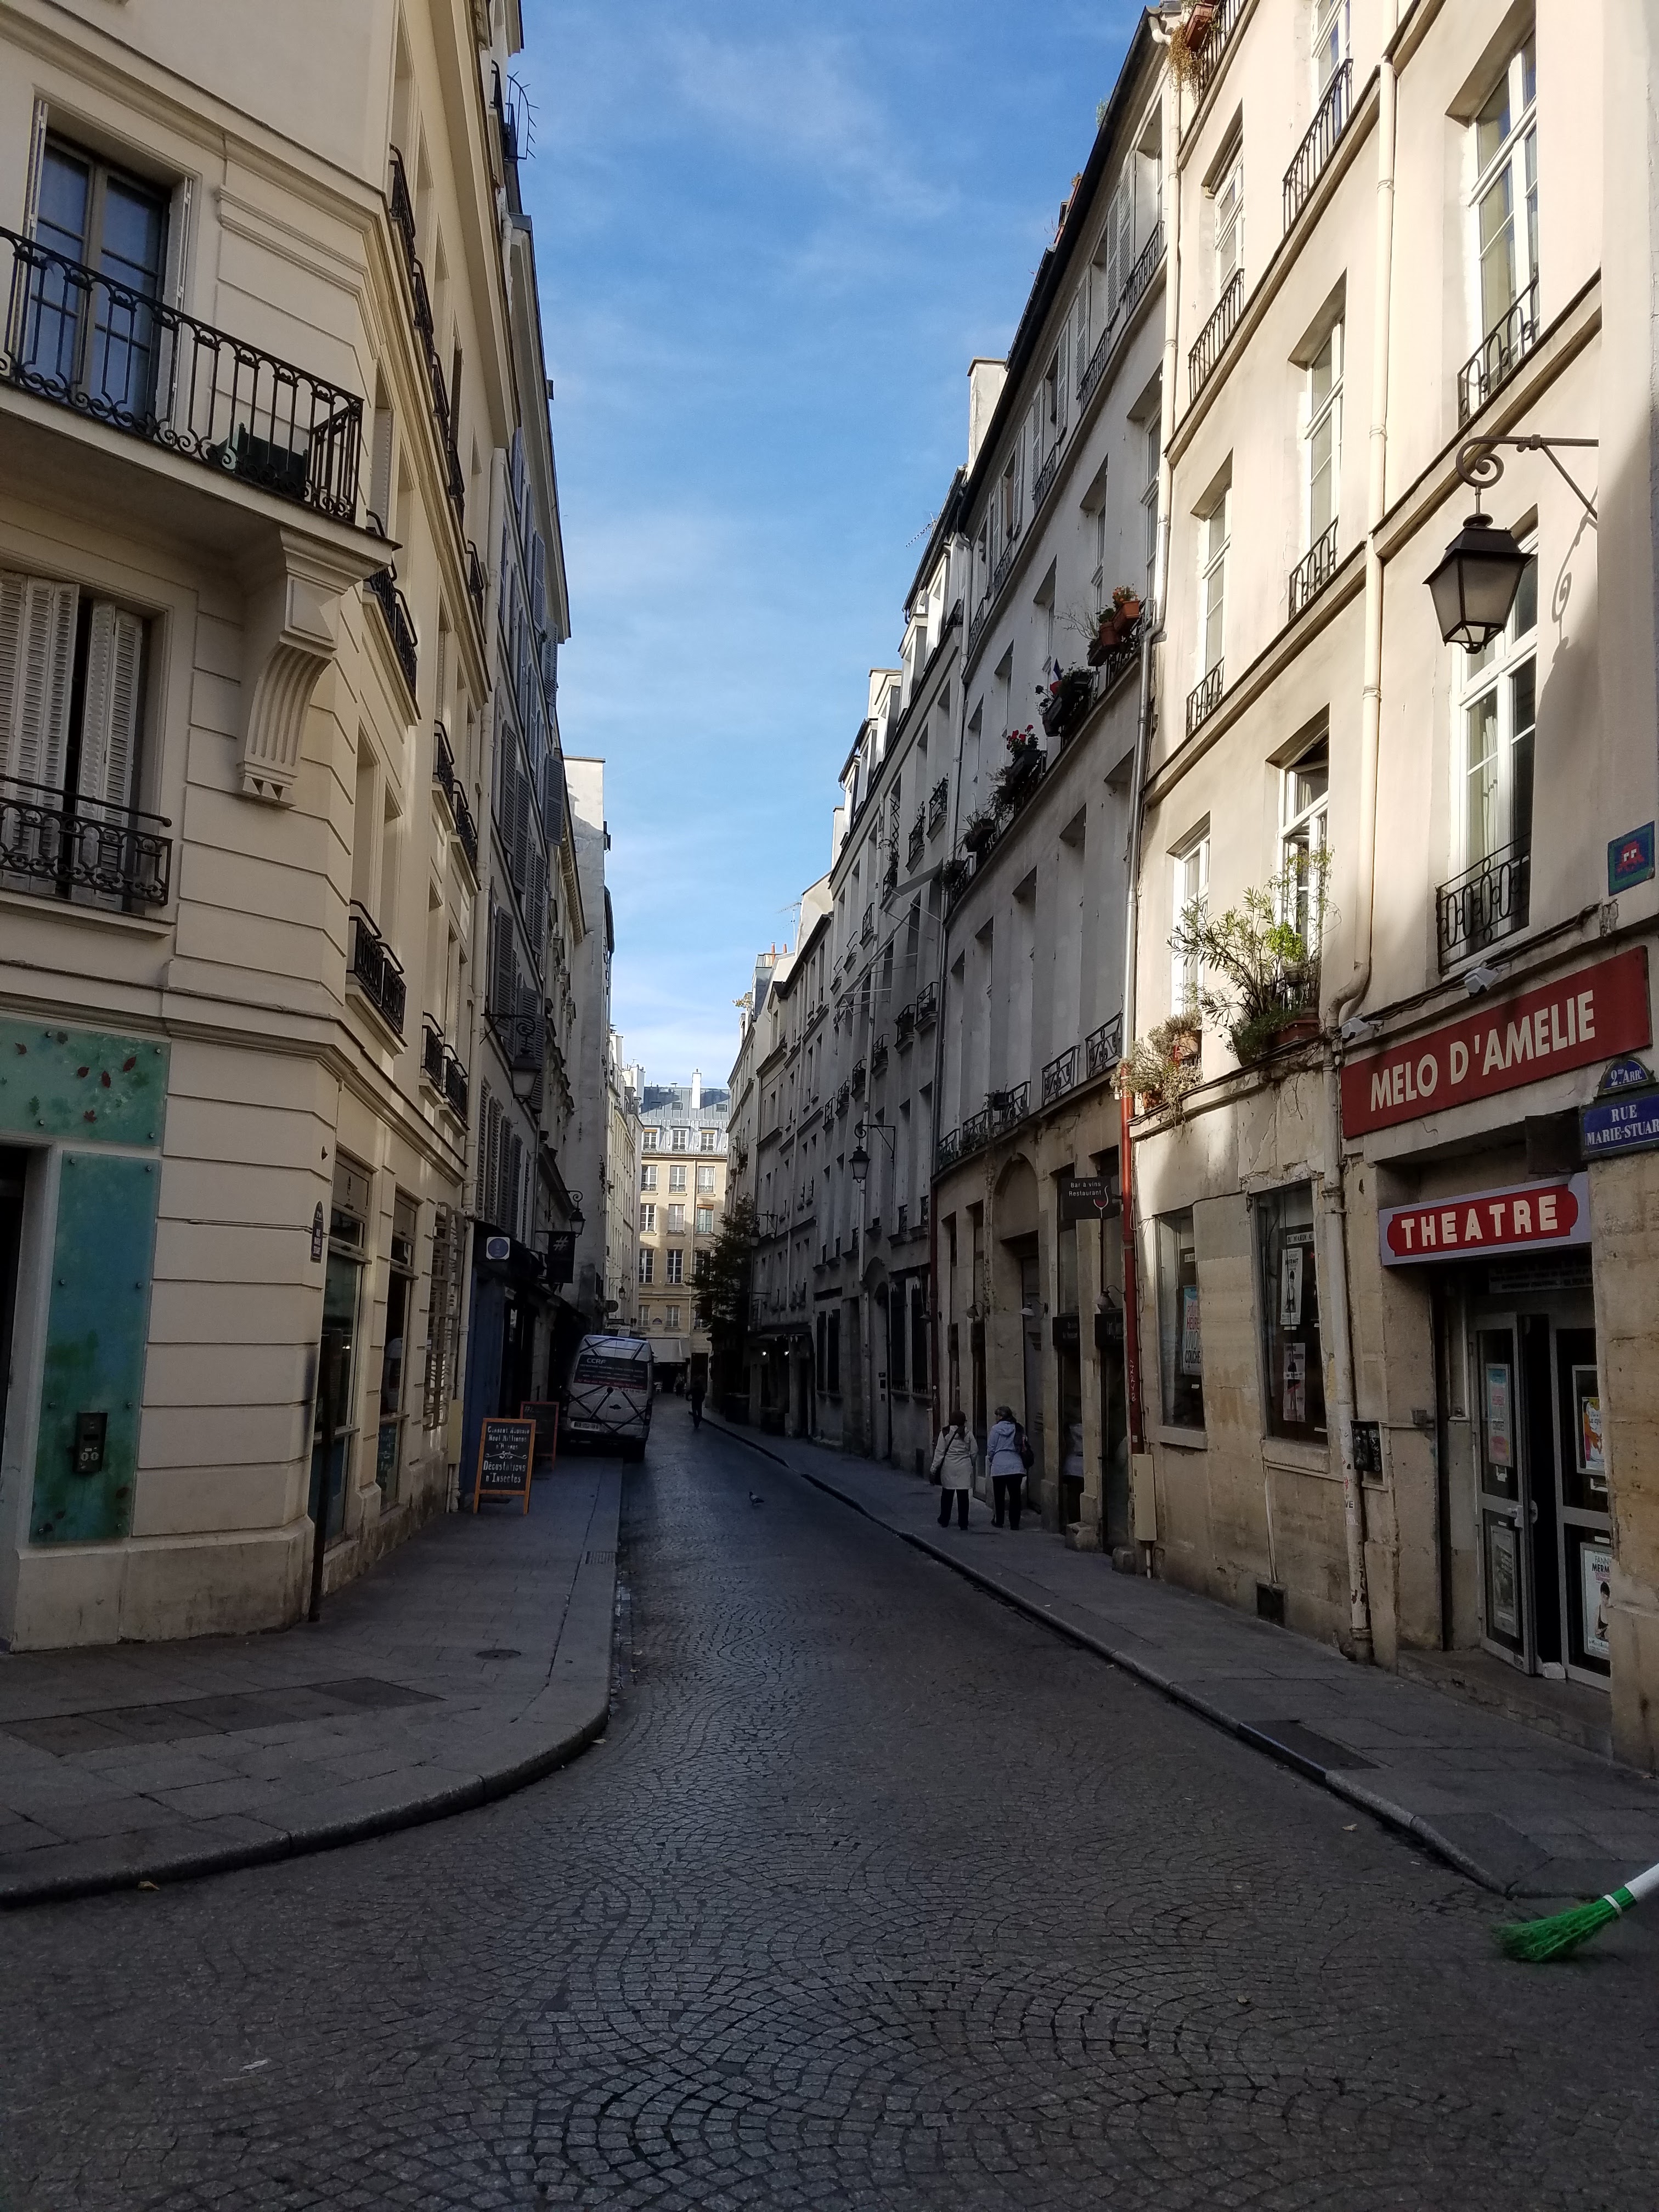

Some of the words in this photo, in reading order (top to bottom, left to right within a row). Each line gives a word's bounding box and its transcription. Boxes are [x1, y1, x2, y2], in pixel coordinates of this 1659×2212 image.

[1370, 1053, 1438, 1112] MELO
[1449, 989, 1595, 1086] D'AMELIE
[1611, 1104, 1638, 1122] RUE
[1293, 1234, 1307, 1242] MARDI
[1401, 1194, 1558, 1249] THEATRE
